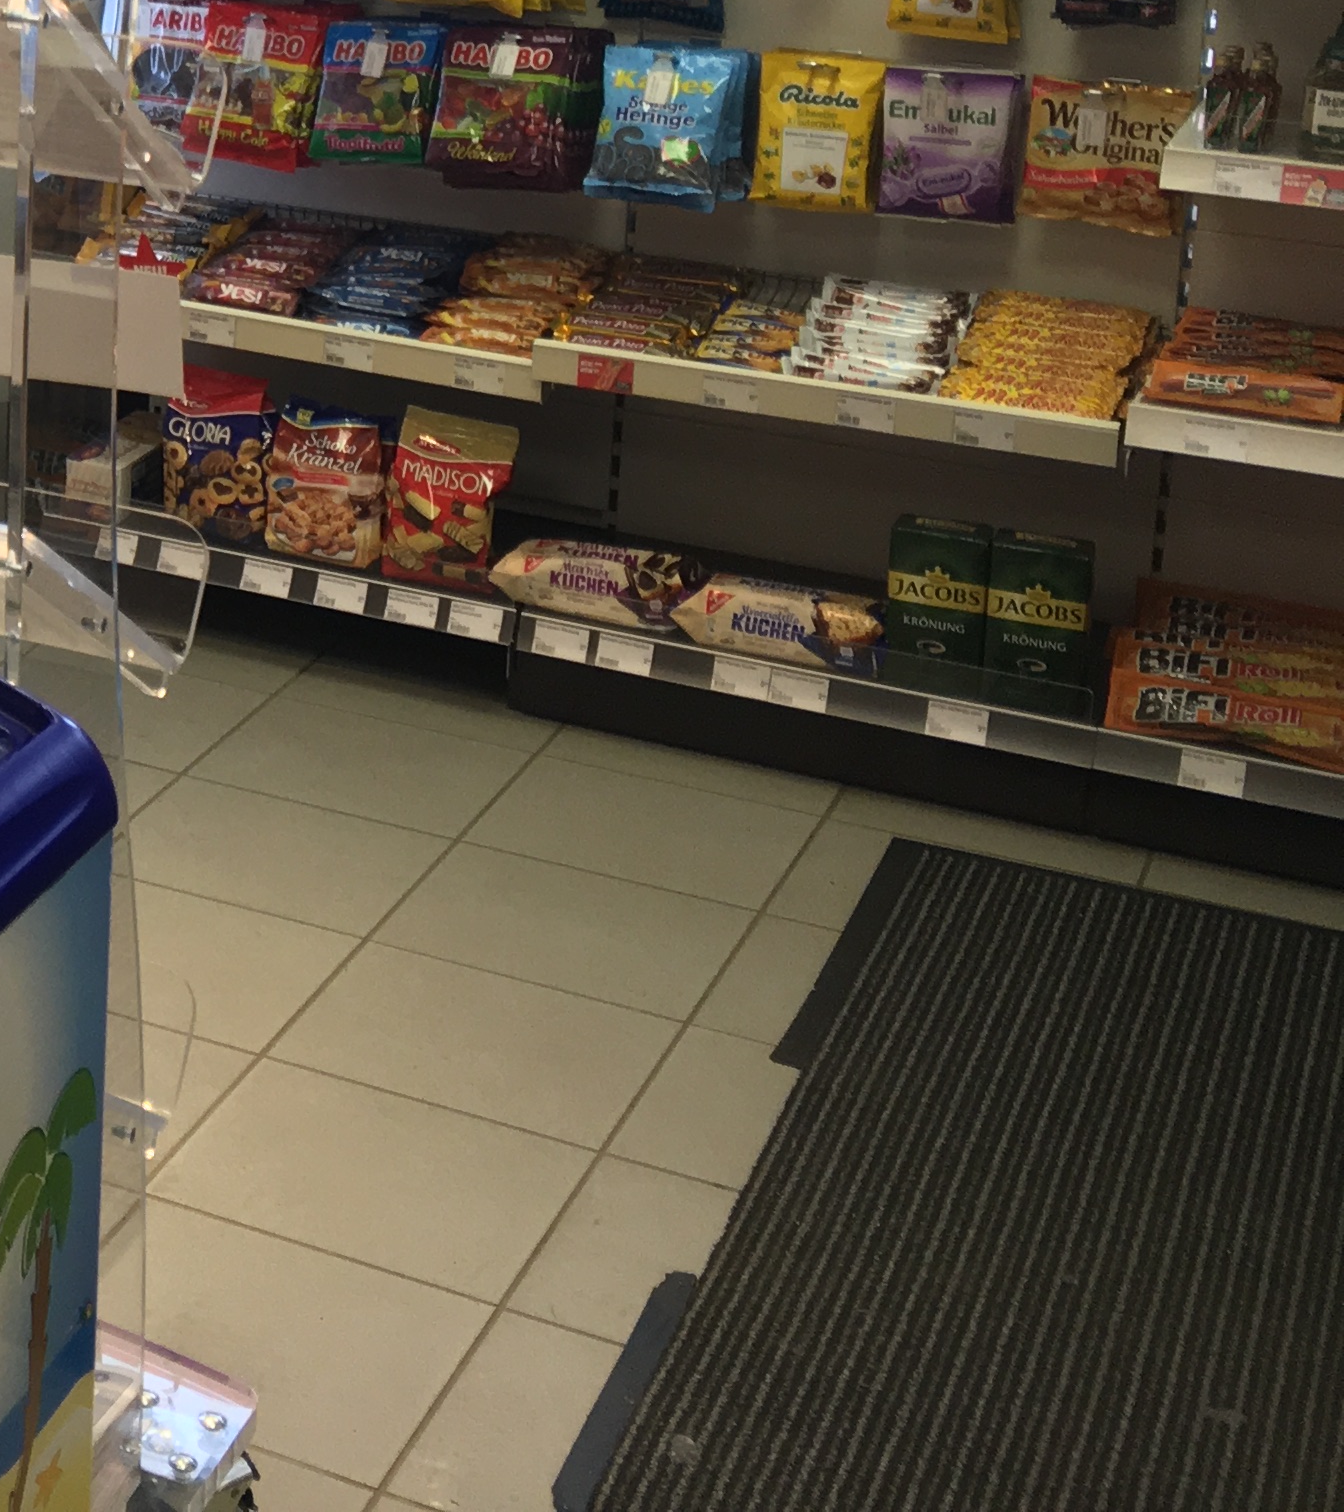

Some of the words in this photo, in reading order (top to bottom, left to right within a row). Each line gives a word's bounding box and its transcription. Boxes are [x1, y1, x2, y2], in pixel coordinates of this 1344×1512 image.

[779, 84, 860, 109] Ricola
[615, 107, 696, 130] Heringe
[167, 416, 232, 446] GLORIA
[305, 431, 358, 455] Schoko
[287, 444, 363, 475] Kränzel
[401, 458, 496, 496] MADISON
[549, 570, 620, 595] KUCHEN
[891, 577, 982, 608] JACOBS
[992, 594, 1085, 626] JACOBS
[731, 612, 806, 643] KUCHEN
[901, 613, 966, 636] KRÖNUNG
[1002, 630, 1068, 653] KRÖNUNG
[1235, 701, 1302, 726] Roll
